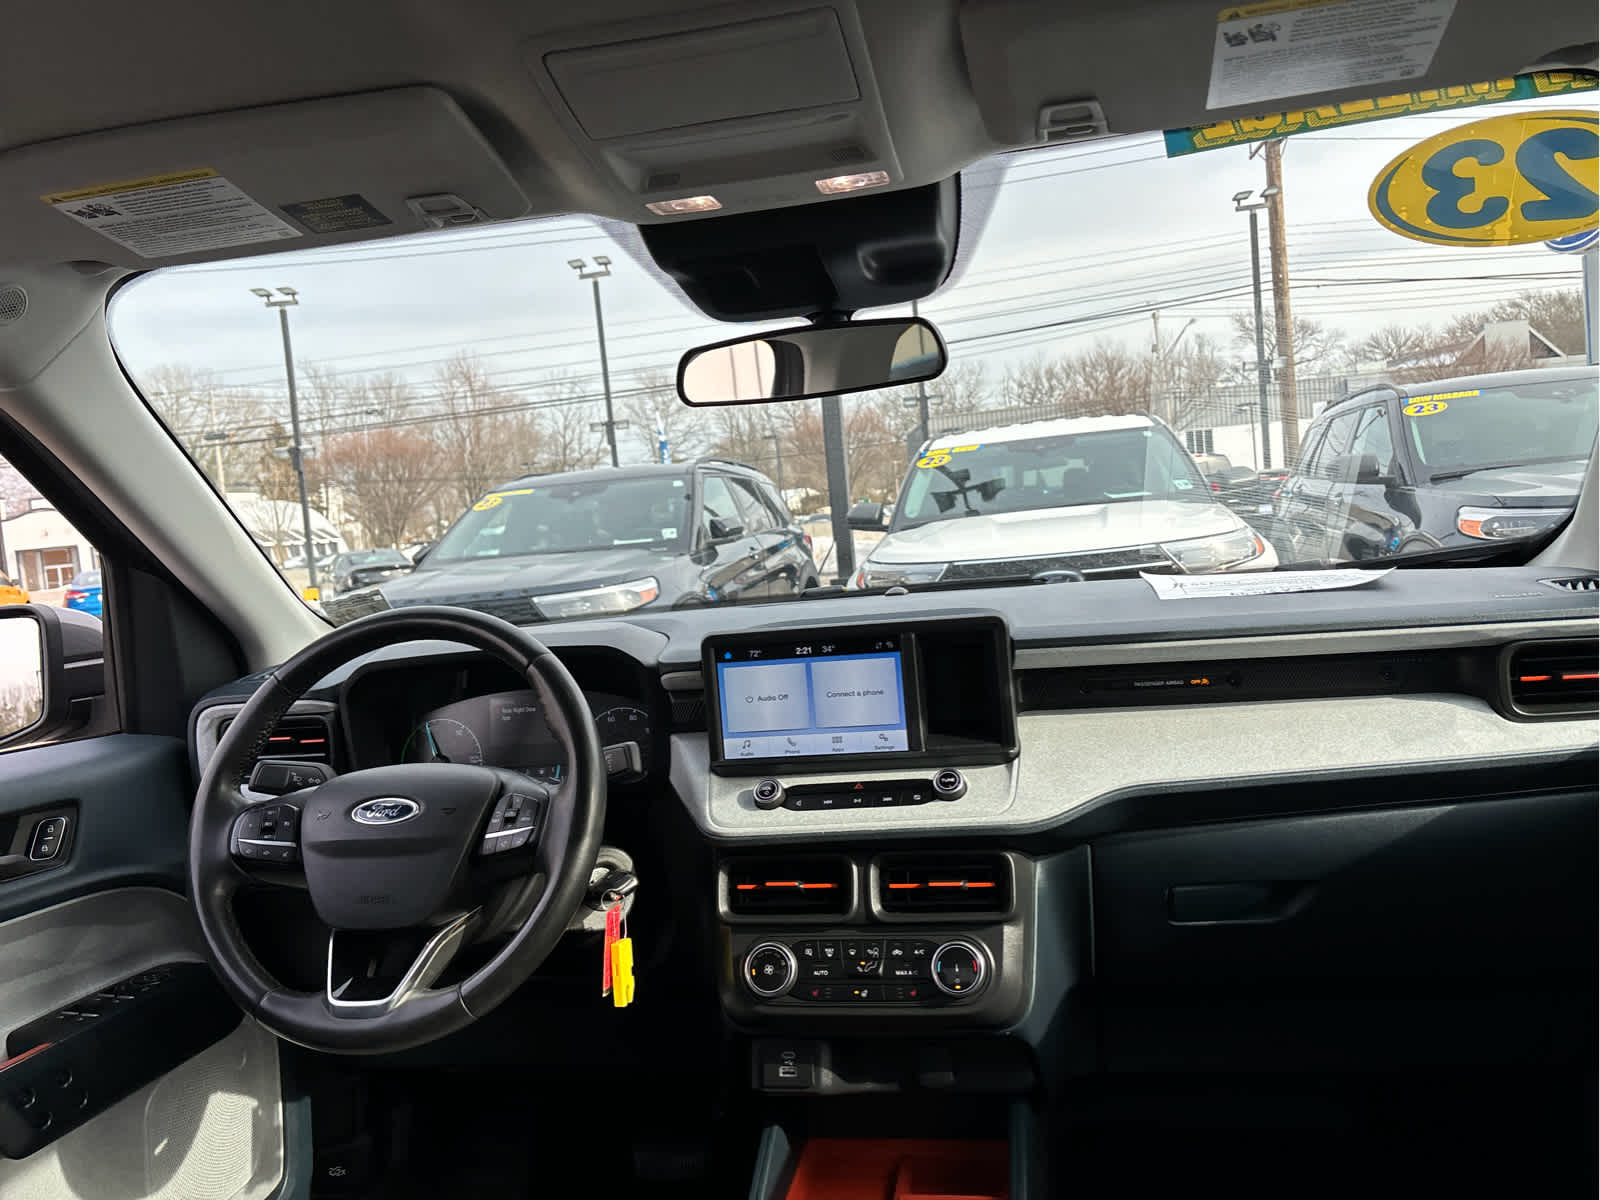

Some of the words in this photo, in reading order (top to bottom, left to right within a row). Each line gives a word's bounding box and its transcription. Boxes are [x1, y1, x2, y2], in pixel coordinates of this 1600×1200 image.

[1413, 403, 1439, 414] 23
[795, 646, 812, 655] 2:21
[757, 694, 777, 702] Audio
[778, 693, 789, 701] Off
[826, 688, 855, 699] Connect
[862, 687, 884, 698] phone
[366, 802, 402, 818] Ford
